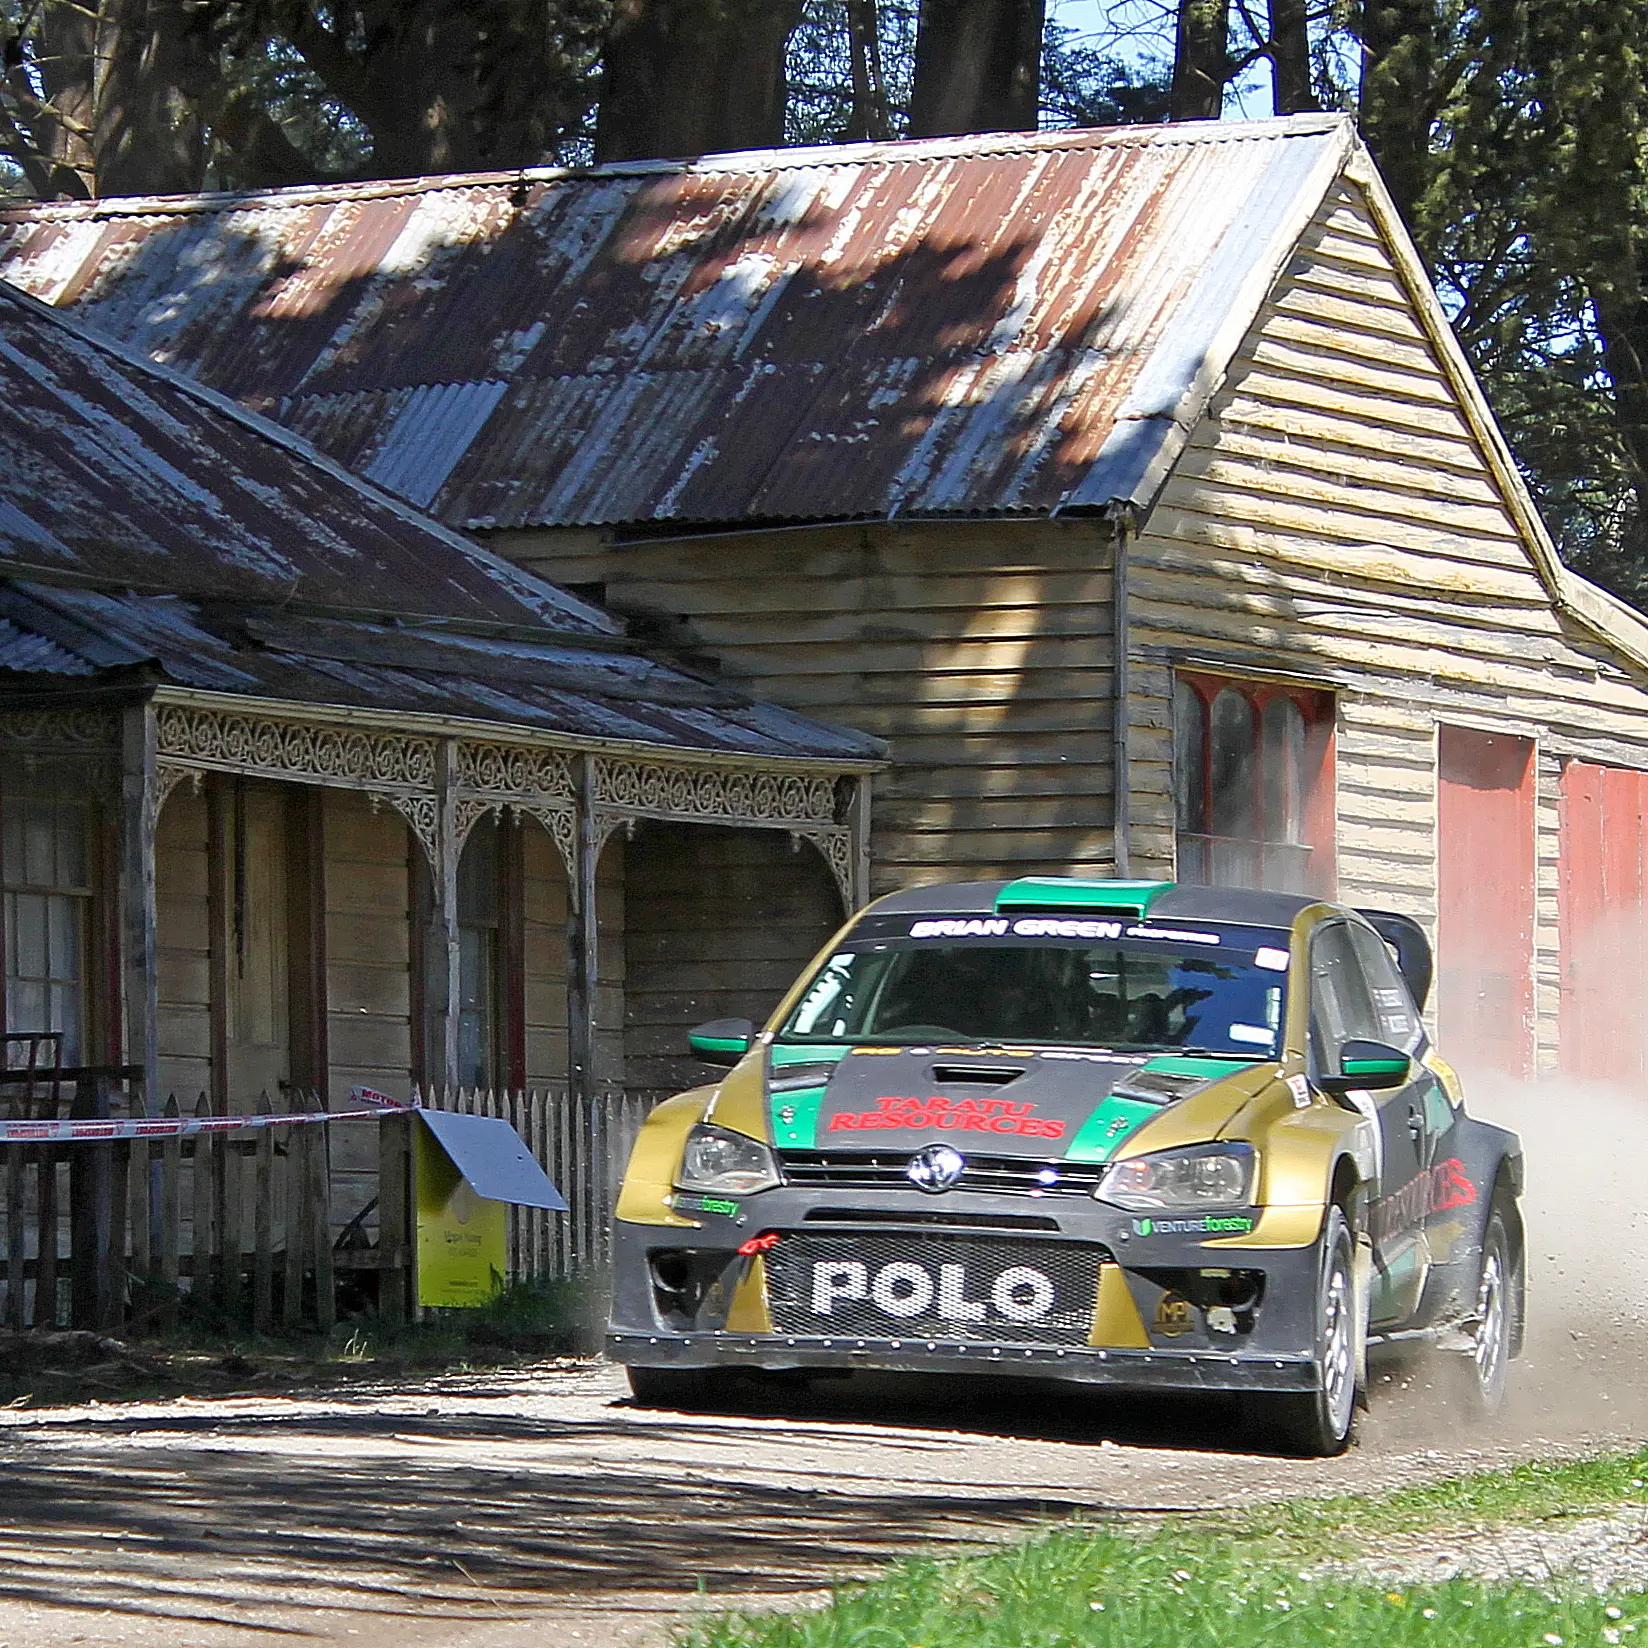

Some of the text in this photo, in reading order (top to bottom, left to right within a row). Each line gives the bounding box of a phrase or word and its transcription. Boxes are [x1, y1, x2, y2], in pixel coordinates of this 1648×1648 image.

[909, 918, 1010, 938] BRIAN
[1012, 918, 1122, 939] GREEN
[874, 1096, 1034, 1117] TARATU
[828, 1111, 1067, 1140] RESOURCES
[810, 1260, 1055, 1322] POLO
